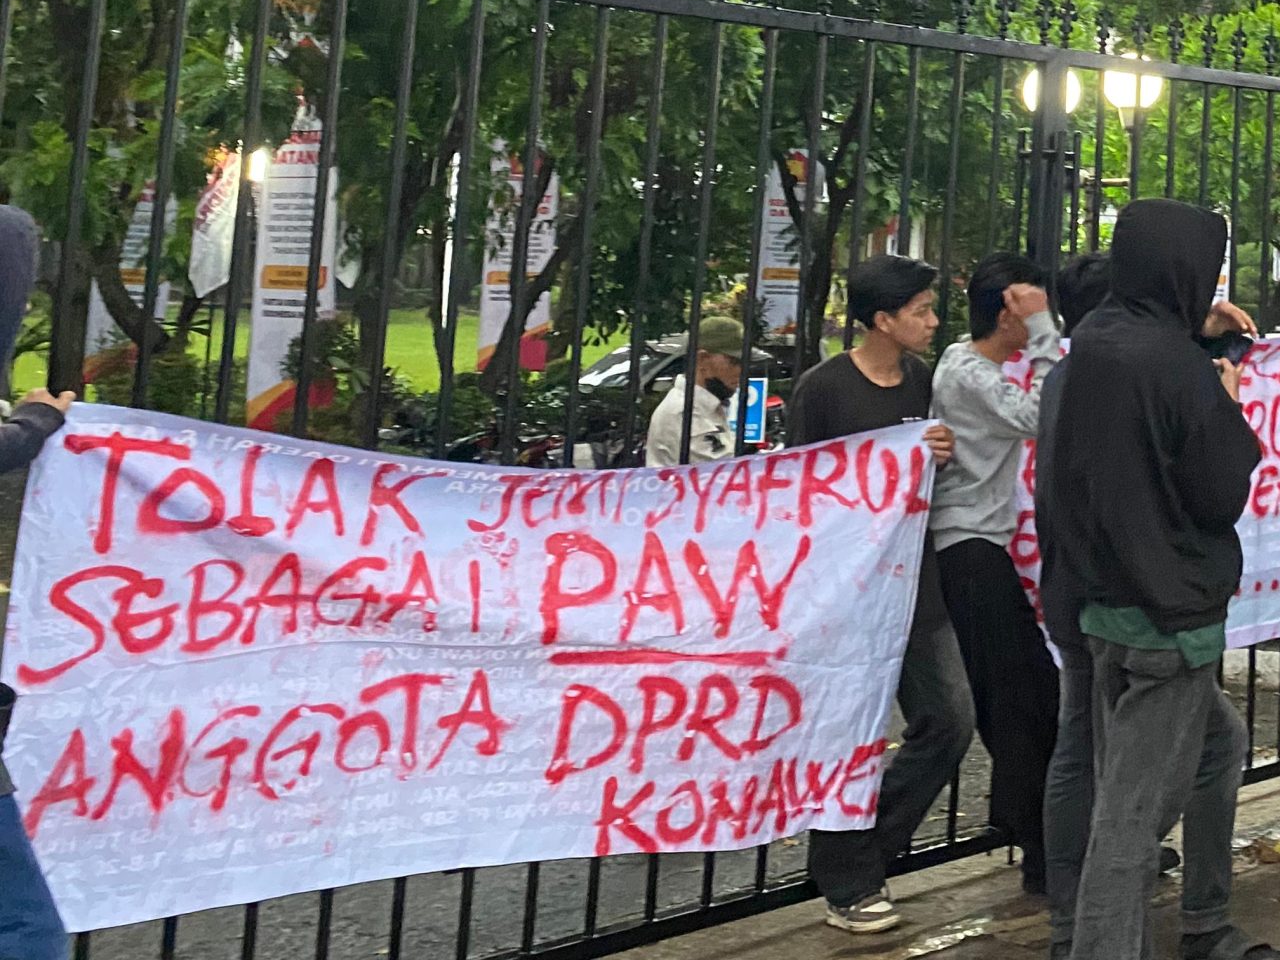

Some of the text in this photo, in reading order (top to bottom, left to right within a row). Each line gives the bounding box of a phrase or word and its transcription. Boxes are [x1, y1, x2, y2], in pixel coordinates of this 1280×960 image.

[65, 432, 446, 554] TOLAK
[646, 440, 930, 532] SYAFRUL
[540, 529, 812, 646] PAW
[26, 670, 801, 841] ANGGOTA DPRD
[595, 740, 887, 857] KONAWE
